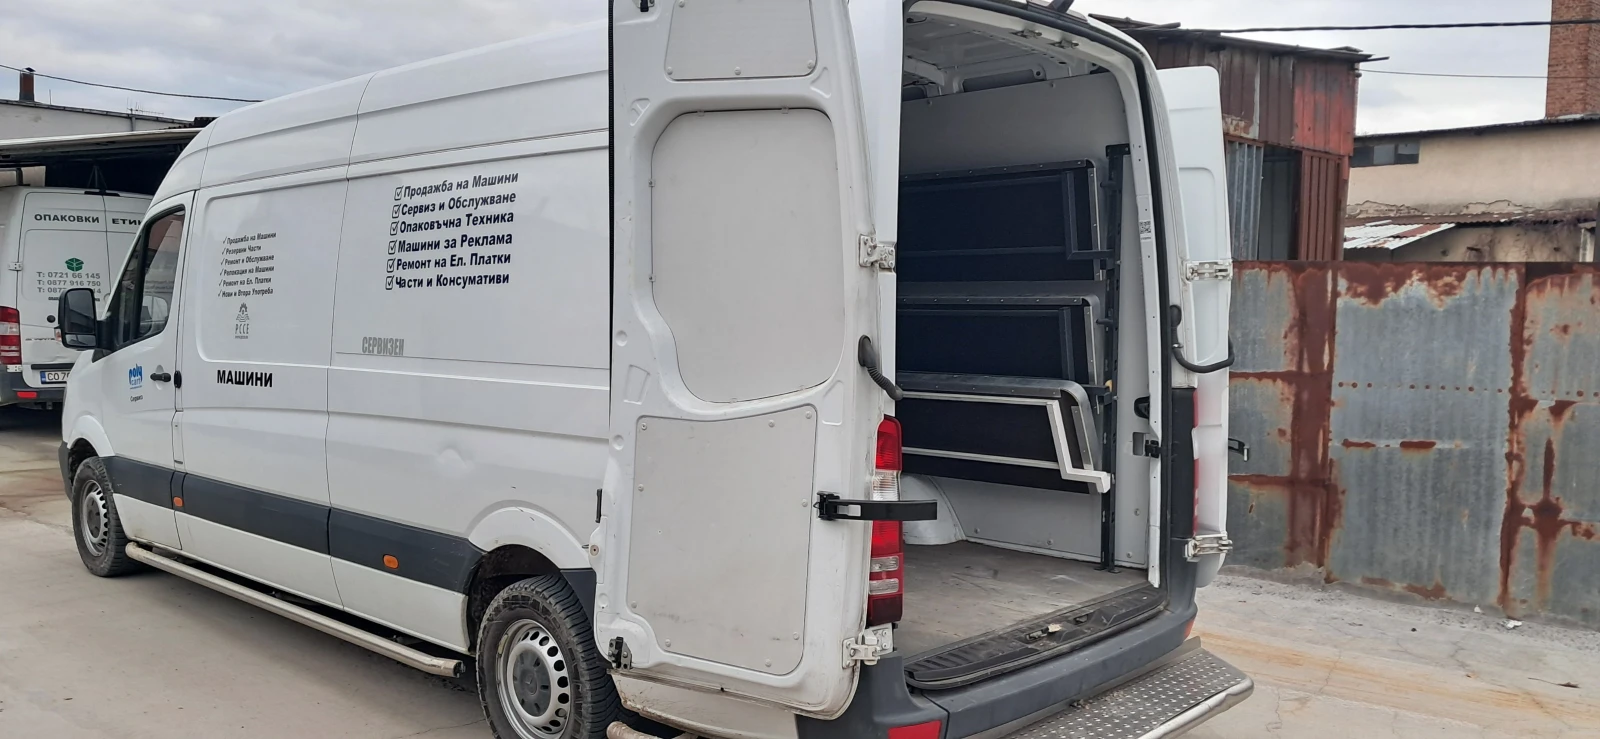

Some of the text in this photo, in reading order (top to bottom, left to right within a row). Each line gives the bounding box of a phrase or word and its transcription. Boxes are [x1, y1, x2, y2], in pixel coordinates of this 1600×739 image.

[403, 172, 519, 200] Продажба на Машини
[401, 192, 516, 217] Сервиз и Обслужване
[34, 214, 99, 223] ОПАКОВКИ
[399, 211, 514, 233] Опаковъчна Техника
[226, 235, 249, 245] Продажба
[256, 232, 277, 241] Машини
[397, 233, 513, 253] Машини за Реклама
[225, 244, 262, 255] Резервни Части
[224, 258, 241, 266] Ремонт
[254, 265, 275, 274] Машини
[396, 252, 511, 271] Ремонт на Ел. Платки
[222, 279, 240, 287] Ремонт
[254, 276, 272, 285] Платки
[395, 273, 510, 289] Части и Консумативи
[251, 286, 274, 296] Употреба
[361, 336, 405, 357] СЕРВИЗЕН
[216, 369, 273, 388] МАШИНИ
